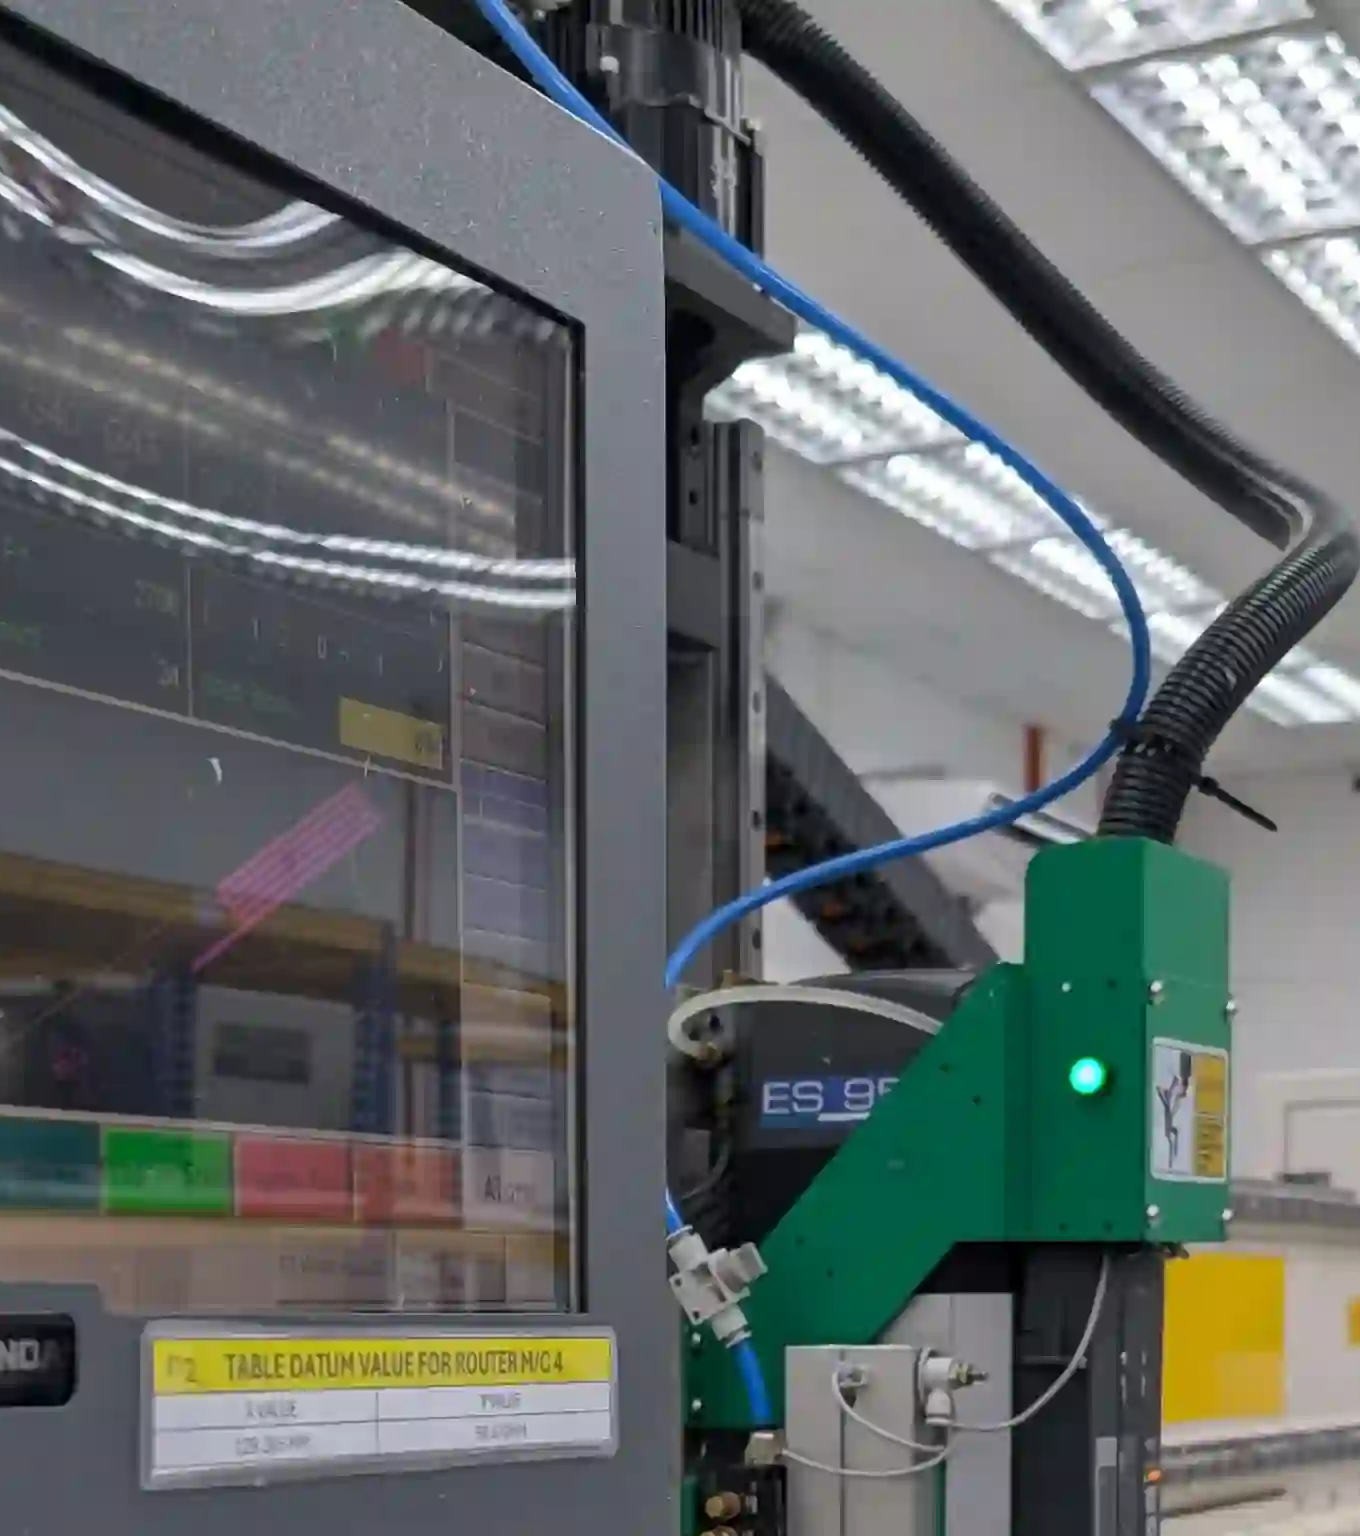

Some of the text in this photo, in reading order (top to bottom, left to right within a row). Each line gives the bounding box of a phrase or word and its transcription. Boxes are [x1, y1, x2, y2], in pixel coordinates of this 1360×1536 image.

[763, 1080, 824, 1115] ES
[225, 1352, 287, 1383] TABLE
[289, 1352, 354, 1380] DATUM
[356, 1352, 417, 1379] VALUE
[418, 1351, 453, 1377] FOR
[455, 1350, 518, 1376] ROUTER
[553, 1350, 564, 1374] 4
